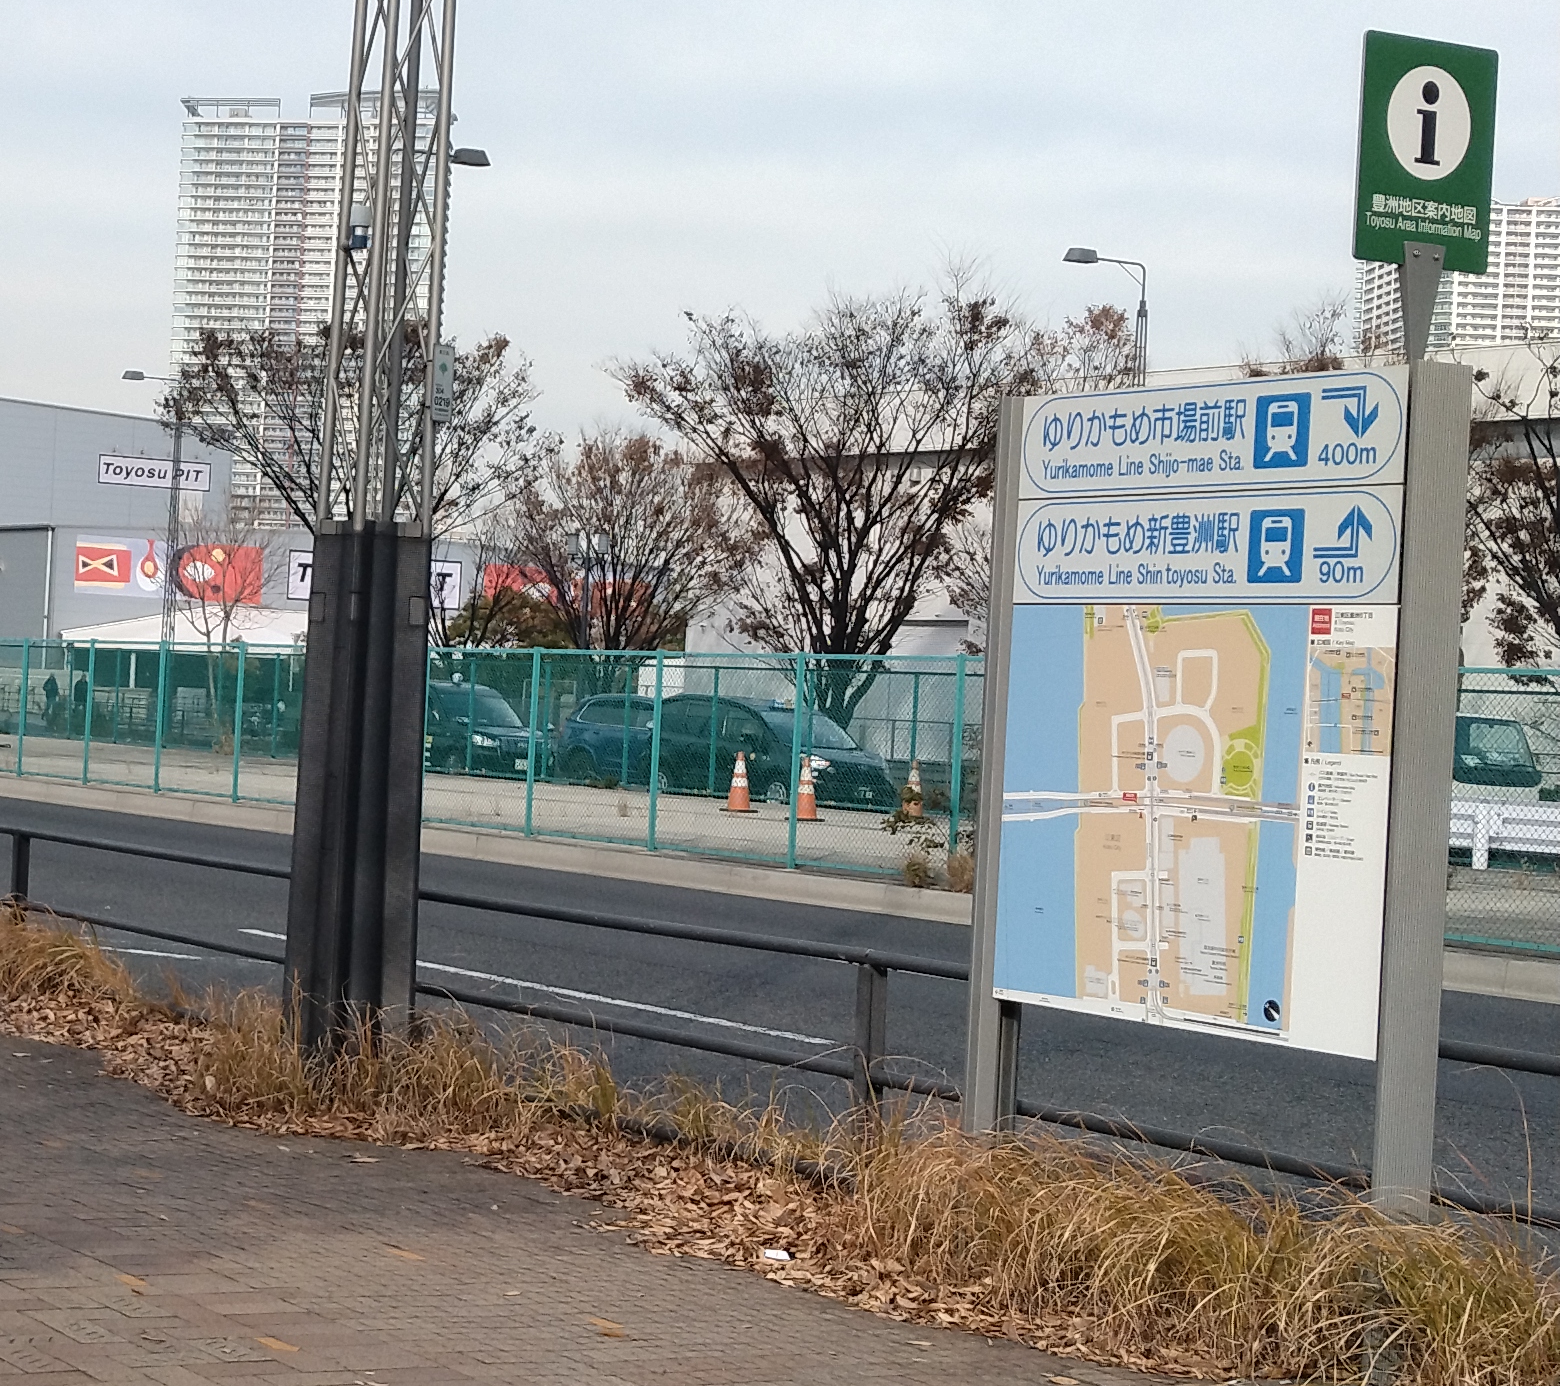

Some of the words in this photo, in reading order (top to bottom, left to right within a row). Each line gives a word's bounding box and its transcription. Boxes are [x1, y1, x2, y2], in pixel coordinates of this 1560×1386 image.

[1371, 193, 1477, 225] 豊洲地区案内地図
[1365, 211, 1396, 230] Toyosu
[1396, 216, 1417, 232] Area
[1418, 219, 1462, 237] Information
[1463, 224, 1482, 242] Map
[433, 395, 451, 408] 0219
[1042, 398, 1247, 453] ゆりかもめ市場前駅
[1041, 456, 1114, 481] Yurikamome
[1117, 454, 1144, 478] Line
[1148, 451, 1213, 479] Shijo-mae
[1317, 442, 1377, 467] 400m
[103, 461, 168, 480] Toyosu
[172, 468, 204, 483] PIT
[1036, 512, 1239, 558] ゆりかもめ新豊洲駅
[1036, 563, 1104, 587] Yurikamome
[1108, 563, 1133, 585] Line
[1212, 562, 1237, 584] Sta.
[1318, 561, 1364, 585] 90m
